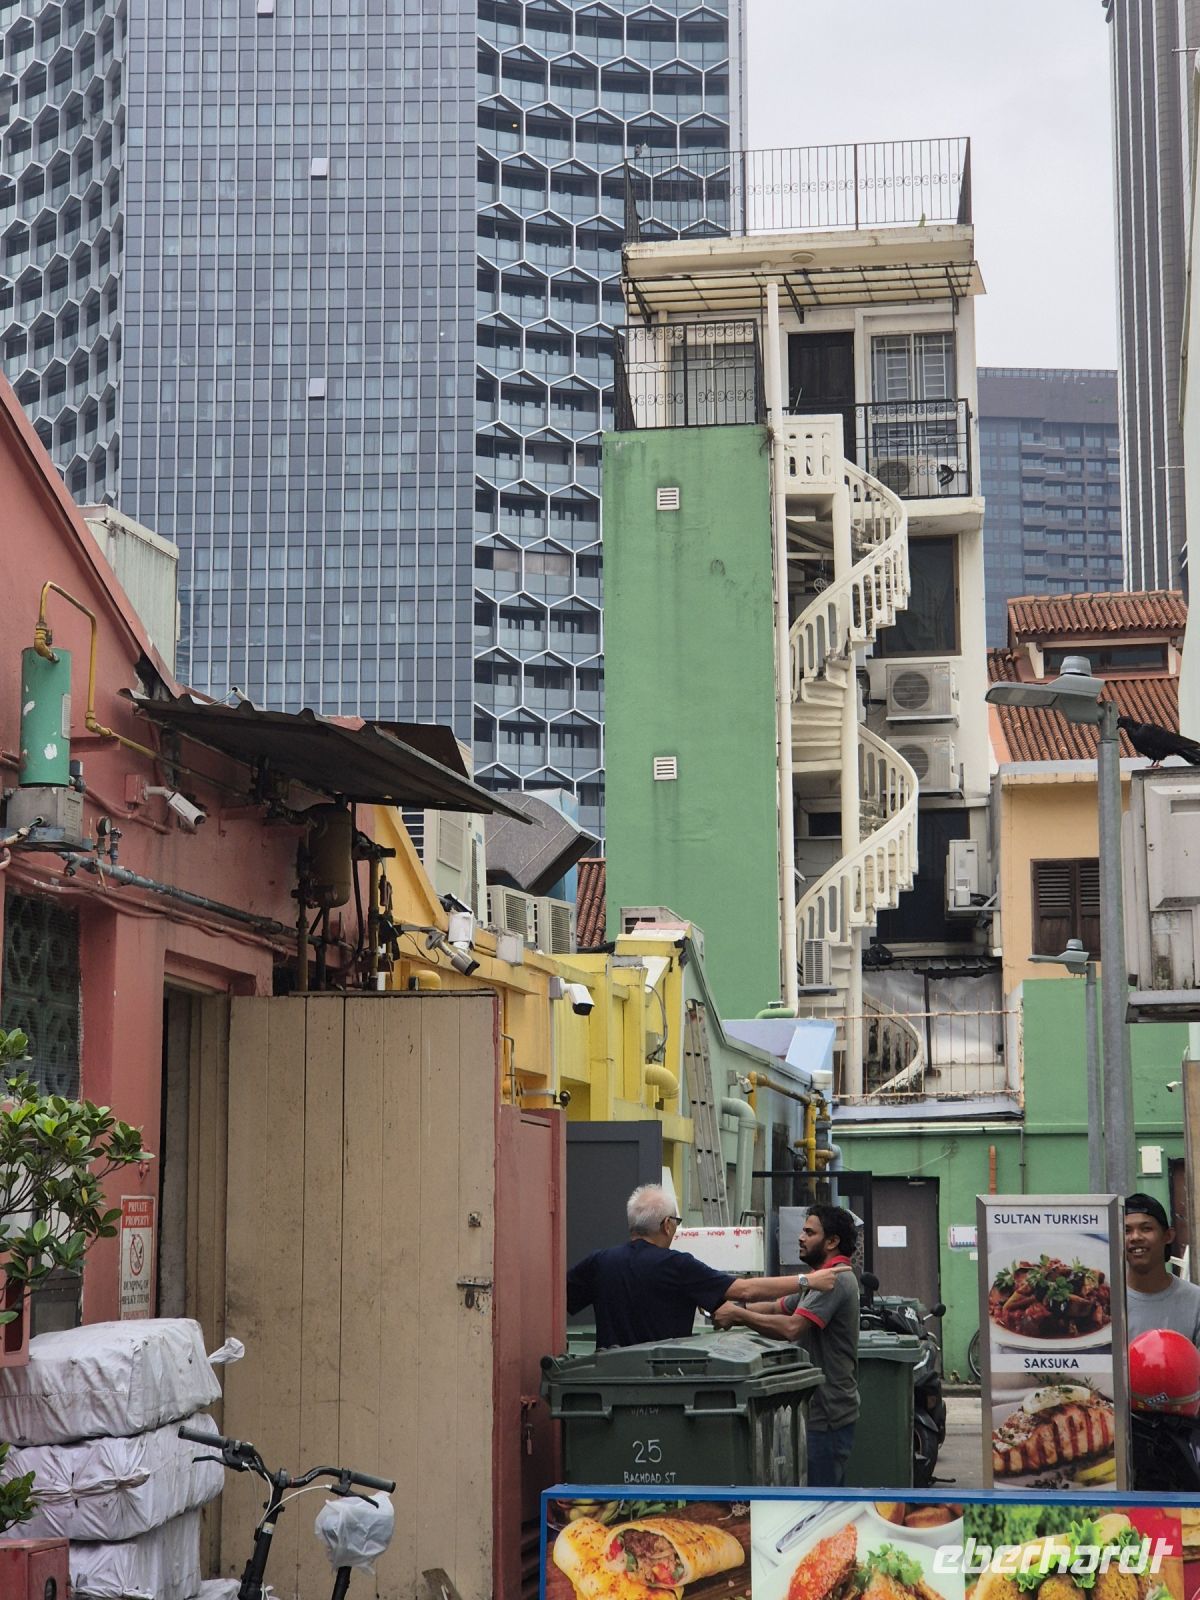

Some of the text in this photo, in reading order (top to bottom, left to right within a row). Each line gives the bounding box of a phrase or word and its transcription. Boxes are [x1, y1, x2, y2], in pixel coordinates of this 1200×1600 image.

[128, 1201, 148, 1213] PRIVATE
[125, 1215, 150, 1227] PROPERTY
[993, 1213, 1099, 1225] SULTAN TURKISH
[1024, 1358, 1079, 1369] SAKSUKA
[632, 1439, 662, 1463] 25
[623, 1471, 677, 1484] BAGHDAD ST
